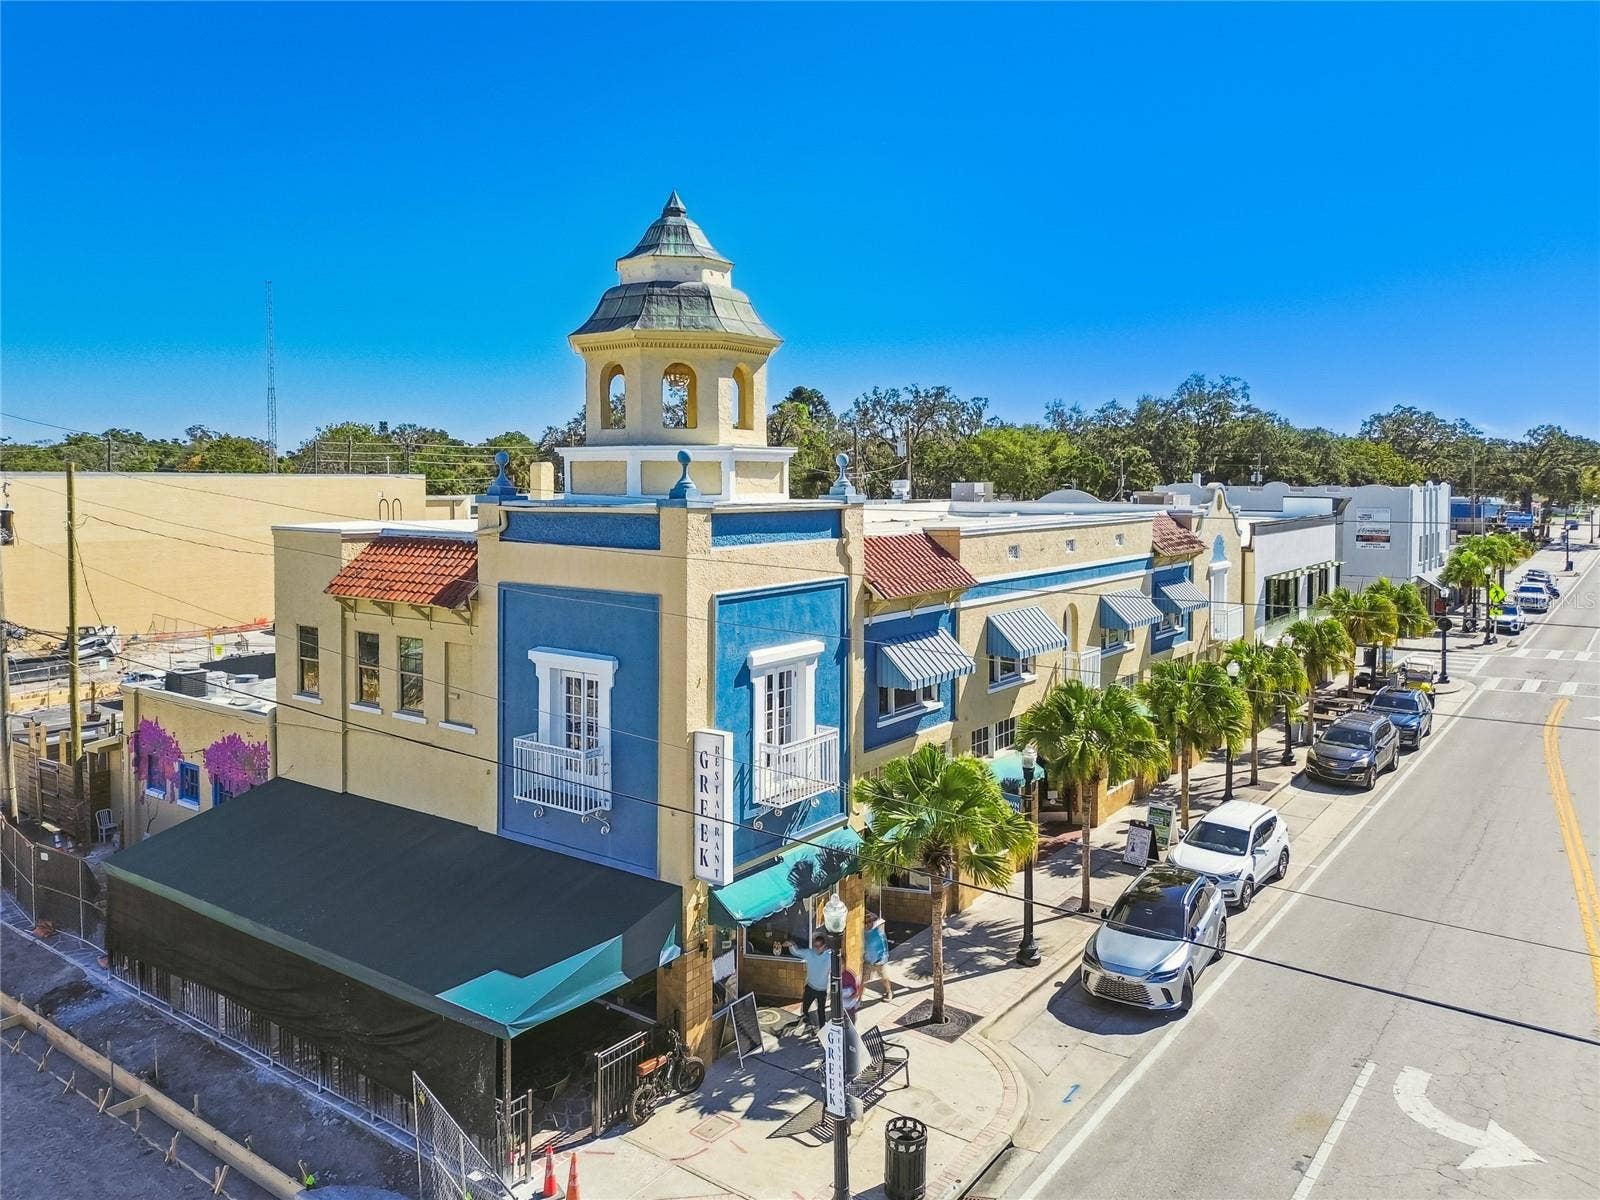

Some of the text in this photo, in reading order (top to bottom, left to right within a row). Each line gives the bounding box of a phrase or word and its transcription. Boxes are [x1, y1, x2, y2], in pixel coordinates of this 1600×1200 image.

[699, 750, 709, 868] GREEK
[713, 745, 721, 878] RESTAURANT
[827, 1032, 836, 1106] GREEK
